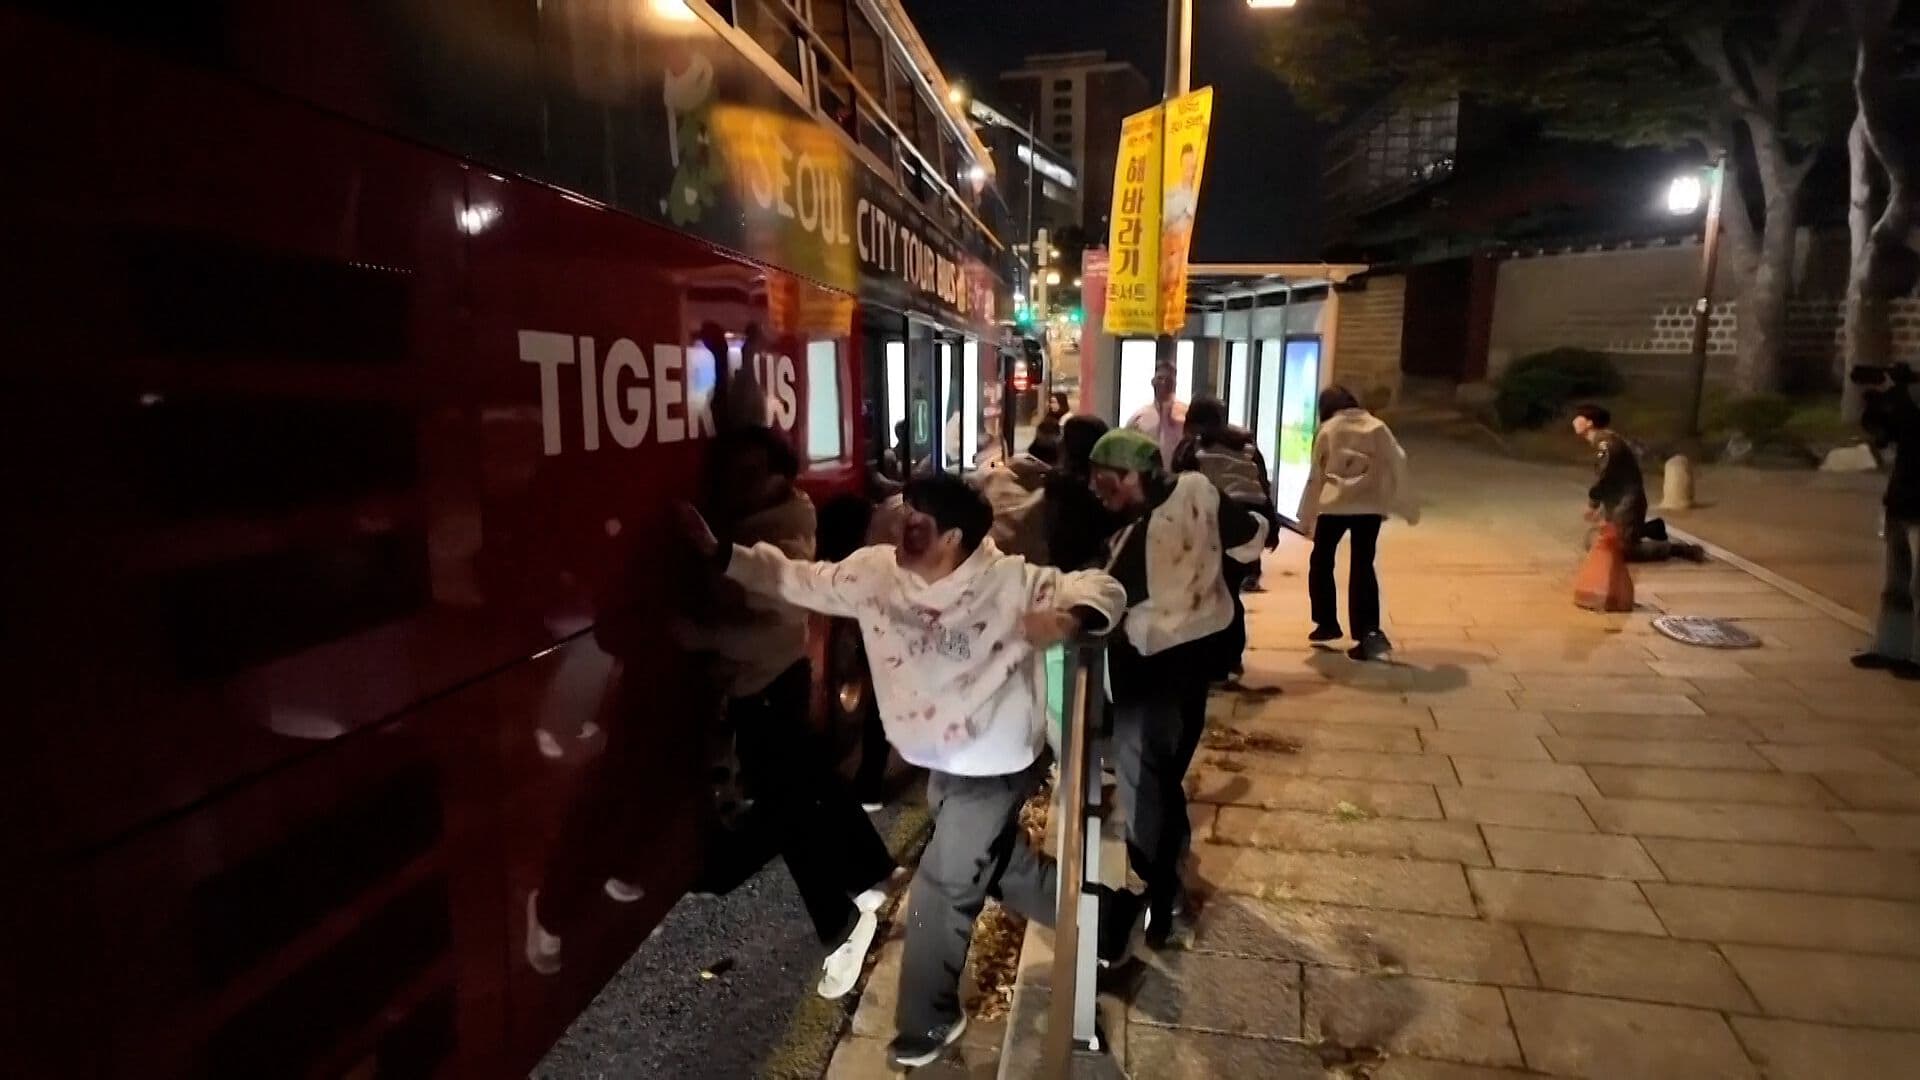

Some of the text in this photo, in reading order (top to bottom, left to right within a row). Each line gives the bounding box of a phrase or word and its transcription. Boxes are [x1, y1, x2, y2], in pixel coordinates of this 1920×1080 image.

[750, 117, 849, 245] SEOUL
[857, 198, 897, 272] CITY
[900, 226, 936, 293] TOUR
[1115, 156, 1147, 278] 해바라기
[517, 329, 797, 456] TIGER US
